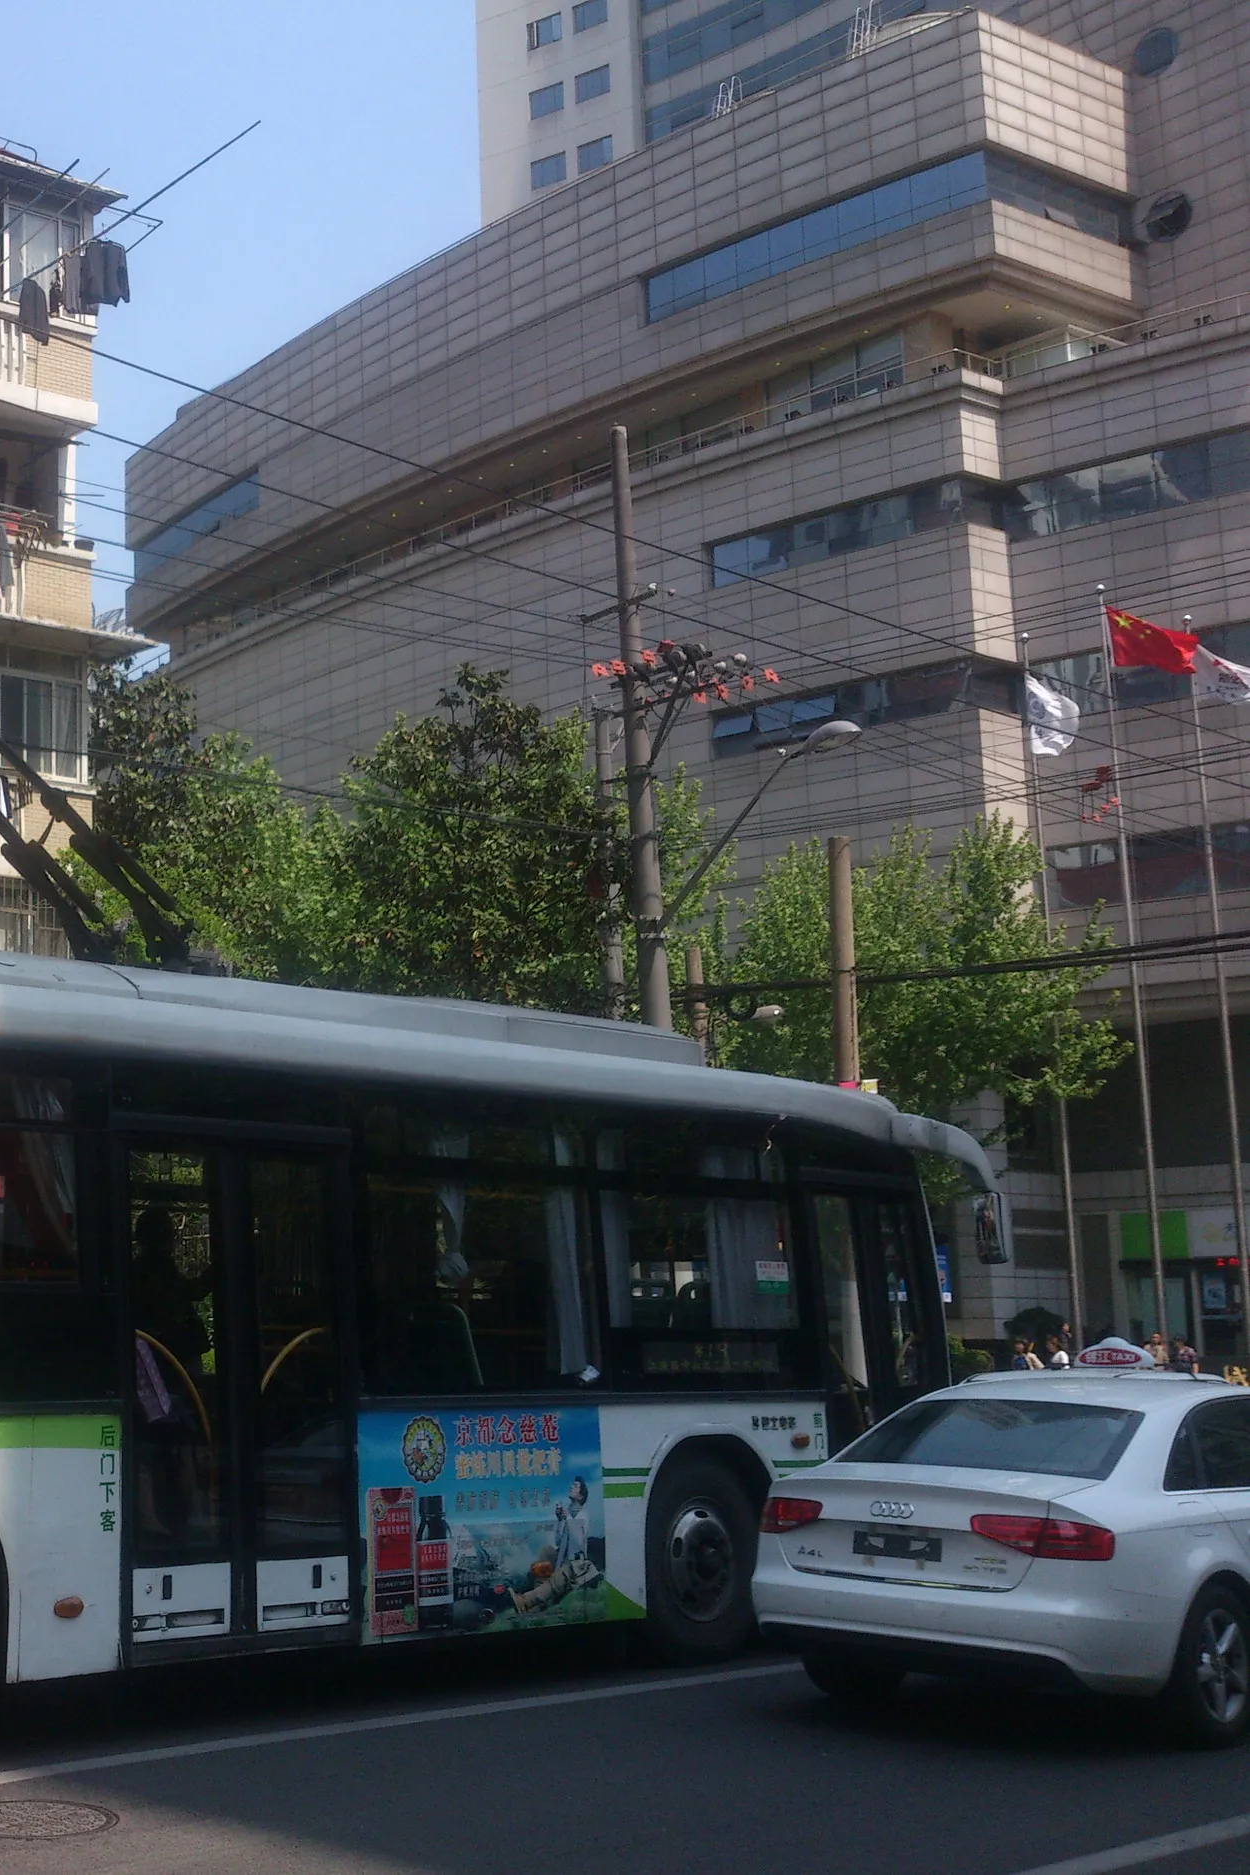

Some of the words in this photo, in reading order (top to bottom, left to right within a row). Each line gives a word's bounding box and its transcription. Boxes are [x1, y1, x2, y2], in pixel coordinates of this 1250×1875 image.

[1112, 1352, 1136, 1362] TAXI
[99, 1424, 116, 1533] 后门下客
[797, 1544, 823, 1558] A4L
